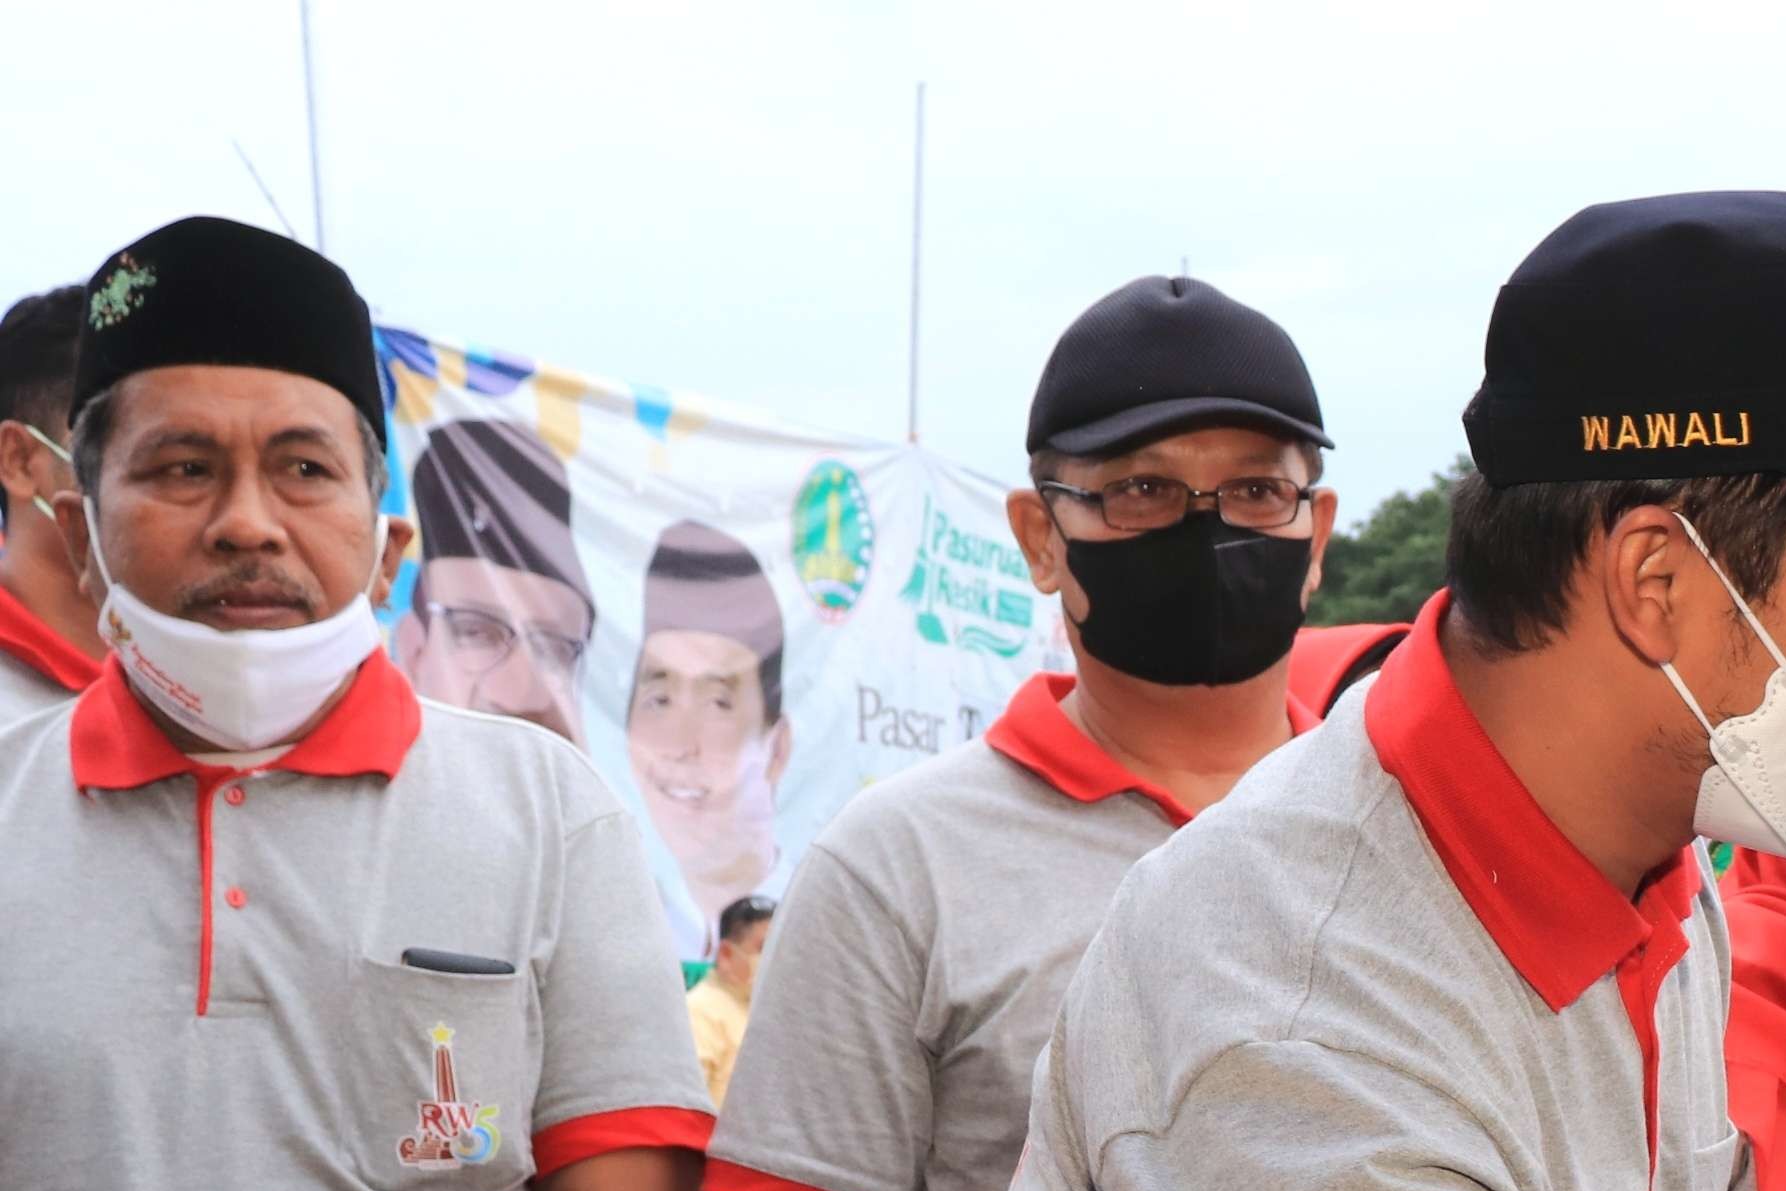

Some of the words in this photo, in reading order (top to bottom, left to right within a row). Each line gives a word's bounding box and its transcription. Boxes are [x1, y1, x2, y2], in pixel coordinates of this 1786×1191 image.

[1581, 412, 1750, 451] WAWALI
[938, 566, 989, 618] Resik
[857, 684, 945, 755] Pasar
